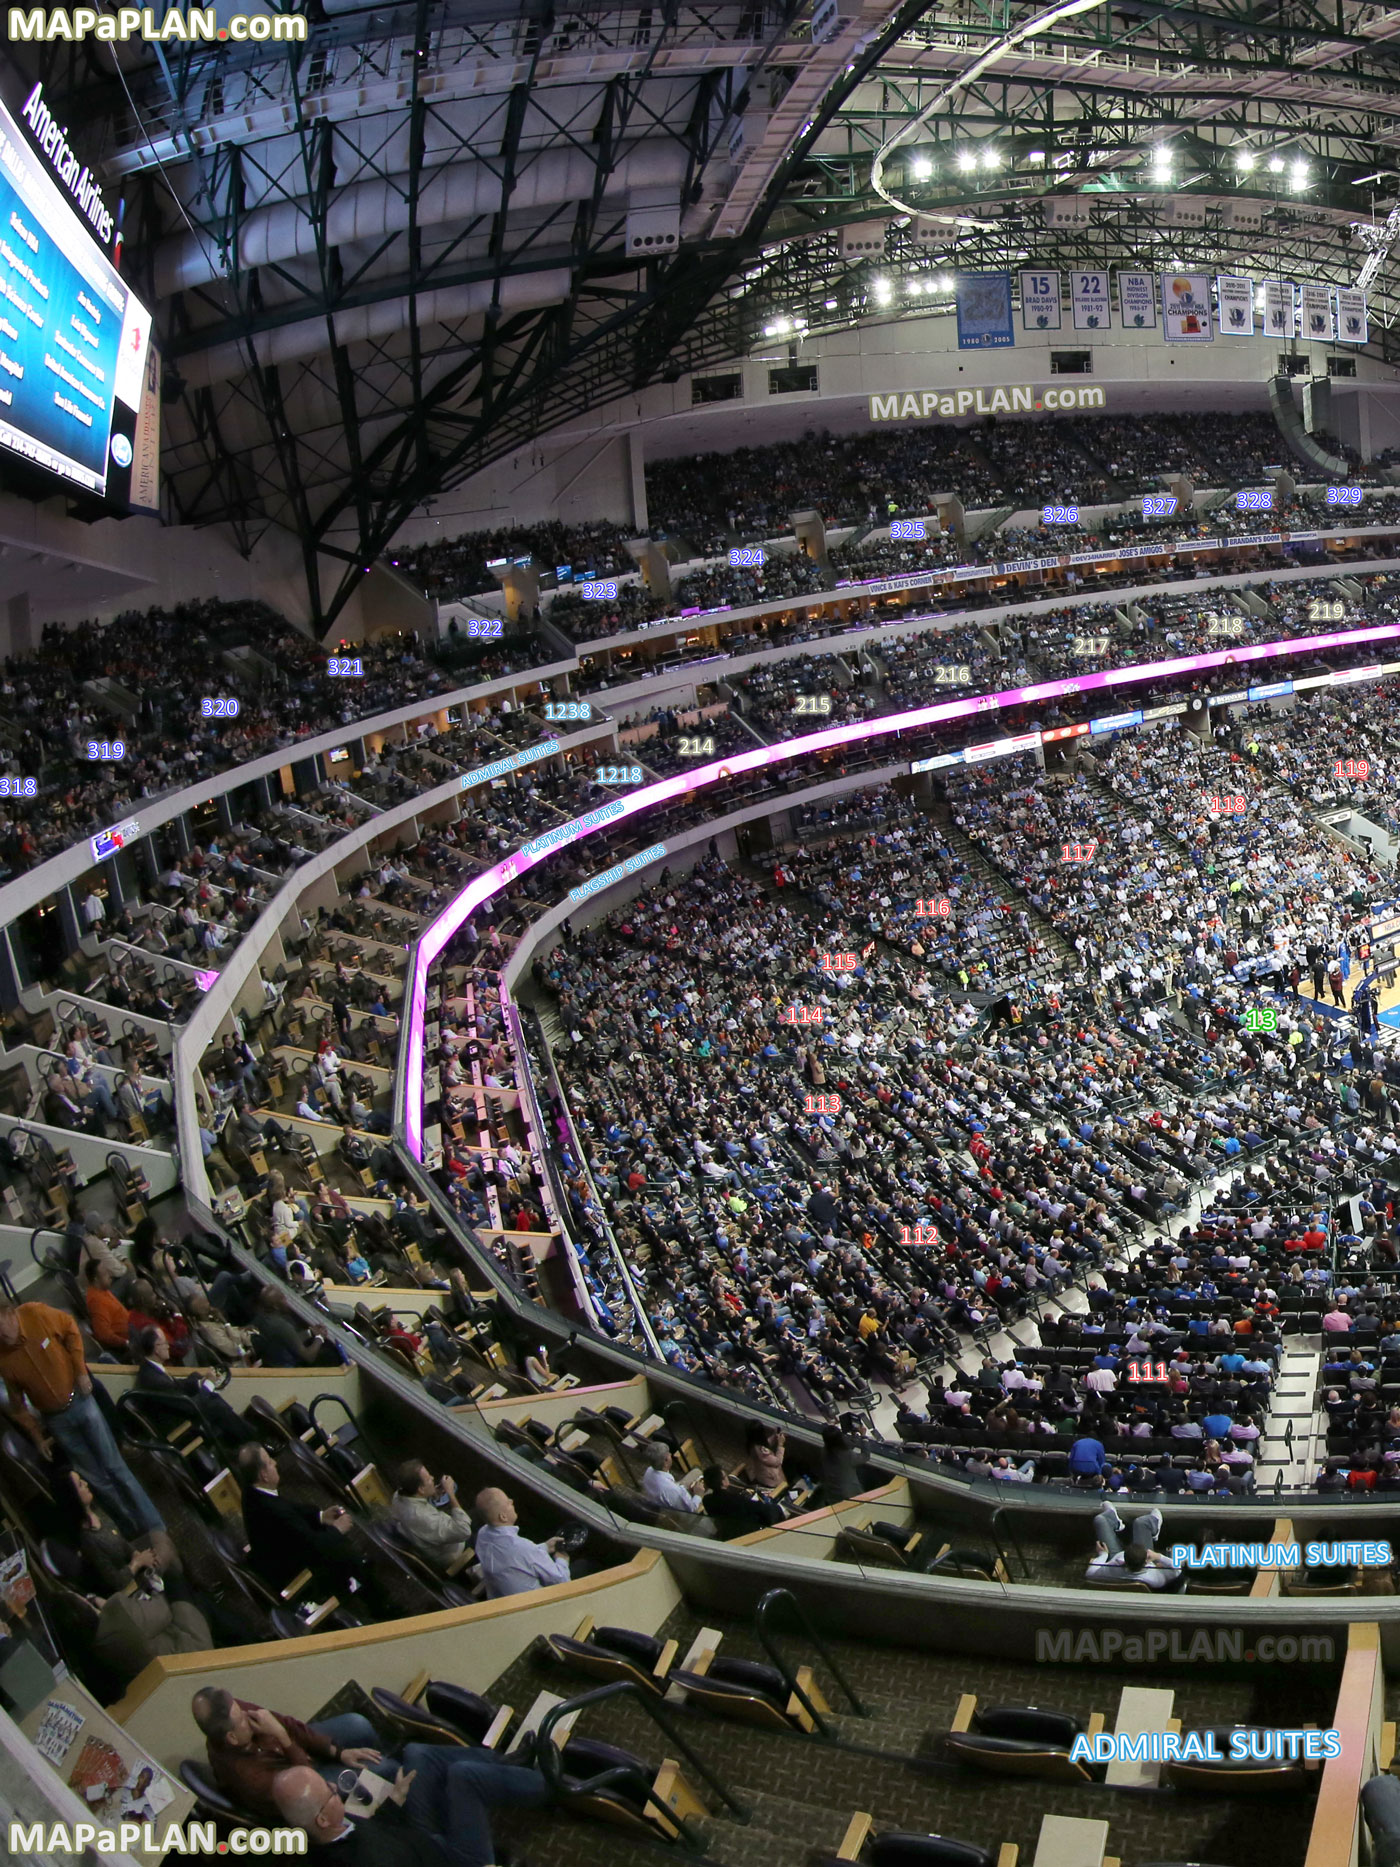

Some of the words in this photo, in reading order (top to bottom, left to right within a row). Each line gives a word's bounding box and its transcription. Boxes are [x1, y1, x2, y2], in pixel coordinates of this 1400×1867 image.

[22, 82, 80, 192] American
[74, 167, 114, 243] Airlines
[1031, 277, 1050, 295] 15
[1081, 276, 1101, 294] 22
[1128, 278, 1145, 286] NBA
[1119, 548, 1138, 558] JOSE'S
[1139, 545, 1163, 556] AMIGOS
[1006, 560, 1038, 573] DEVIN'S
[1041, 557, 1057, 568] DEN
[910, 577, 932, 588] CORNER
